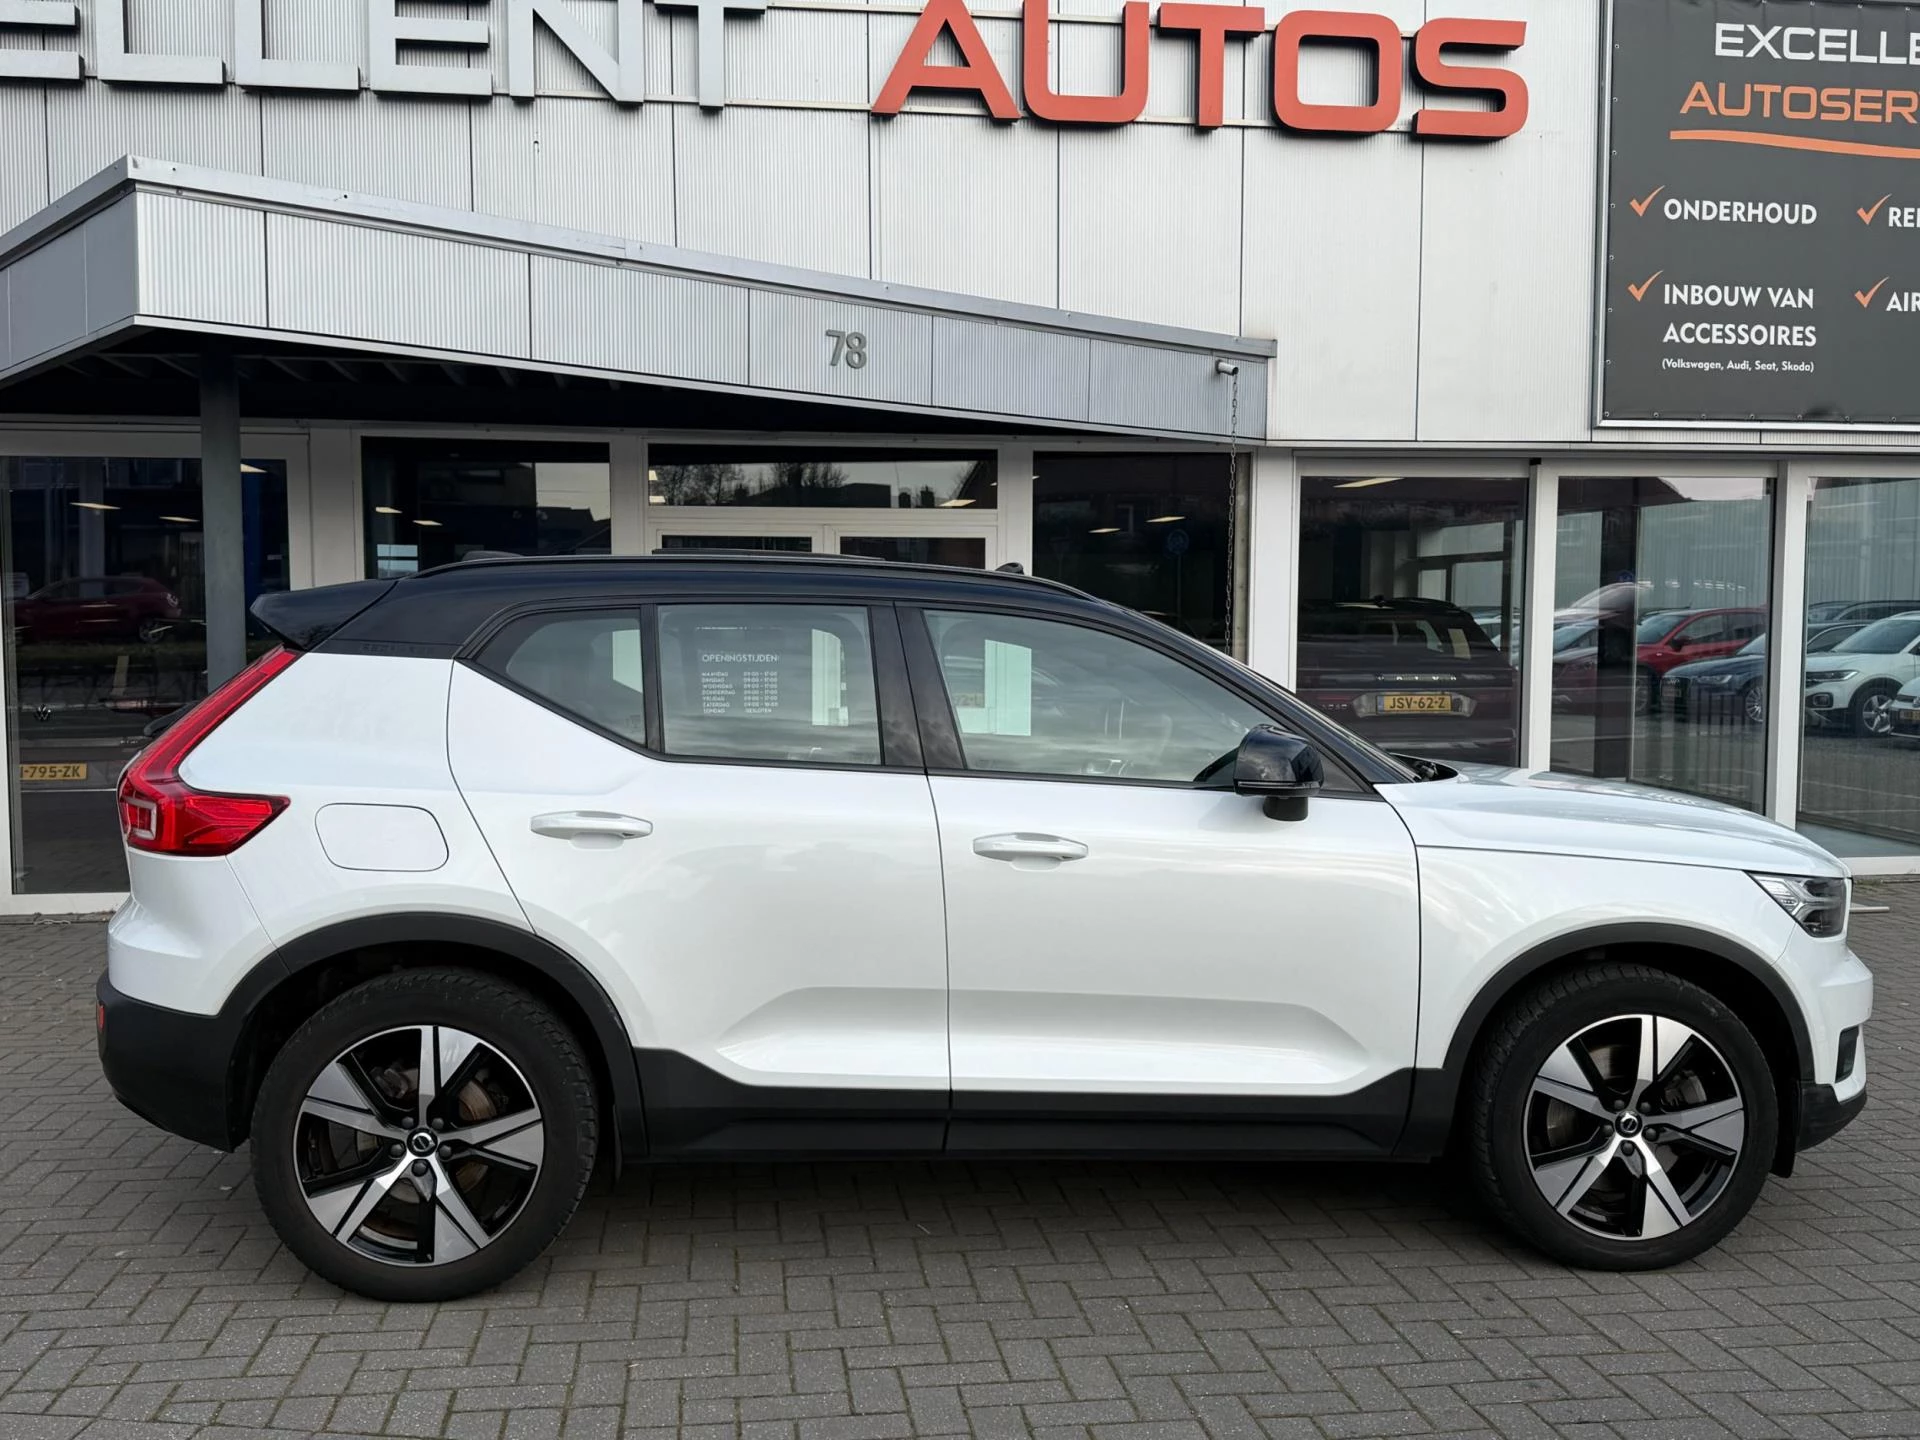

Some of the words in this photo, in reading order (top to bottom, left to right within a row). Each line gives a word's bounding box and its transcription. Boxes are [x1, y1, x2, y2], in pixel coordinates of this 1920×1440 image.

[871, 0, 1529, 140] AUTOS
[1679, 81, 1920, 124] AUTOSER
[1663, 198, 1817, 225] ONDERHOUD
[1888, 206, 1920, 229] RE
[1663, 283, 1761, 308] INBOUW
[1767, 288, 1814, 309] VAN
[1663, 322, 1817, 347] ACCESSOIRES
[824, 329, 868, 370] 78
[1661, 358, 1725, 372] (Volkswagen,
[1727, 359, 1752, 372] Audi,
[1754, 360, 1779, 373] Seat,
[1781, 360, 1814, 373] Skoda)
[1389, 697, 1446, 710] JSV-62-Z
